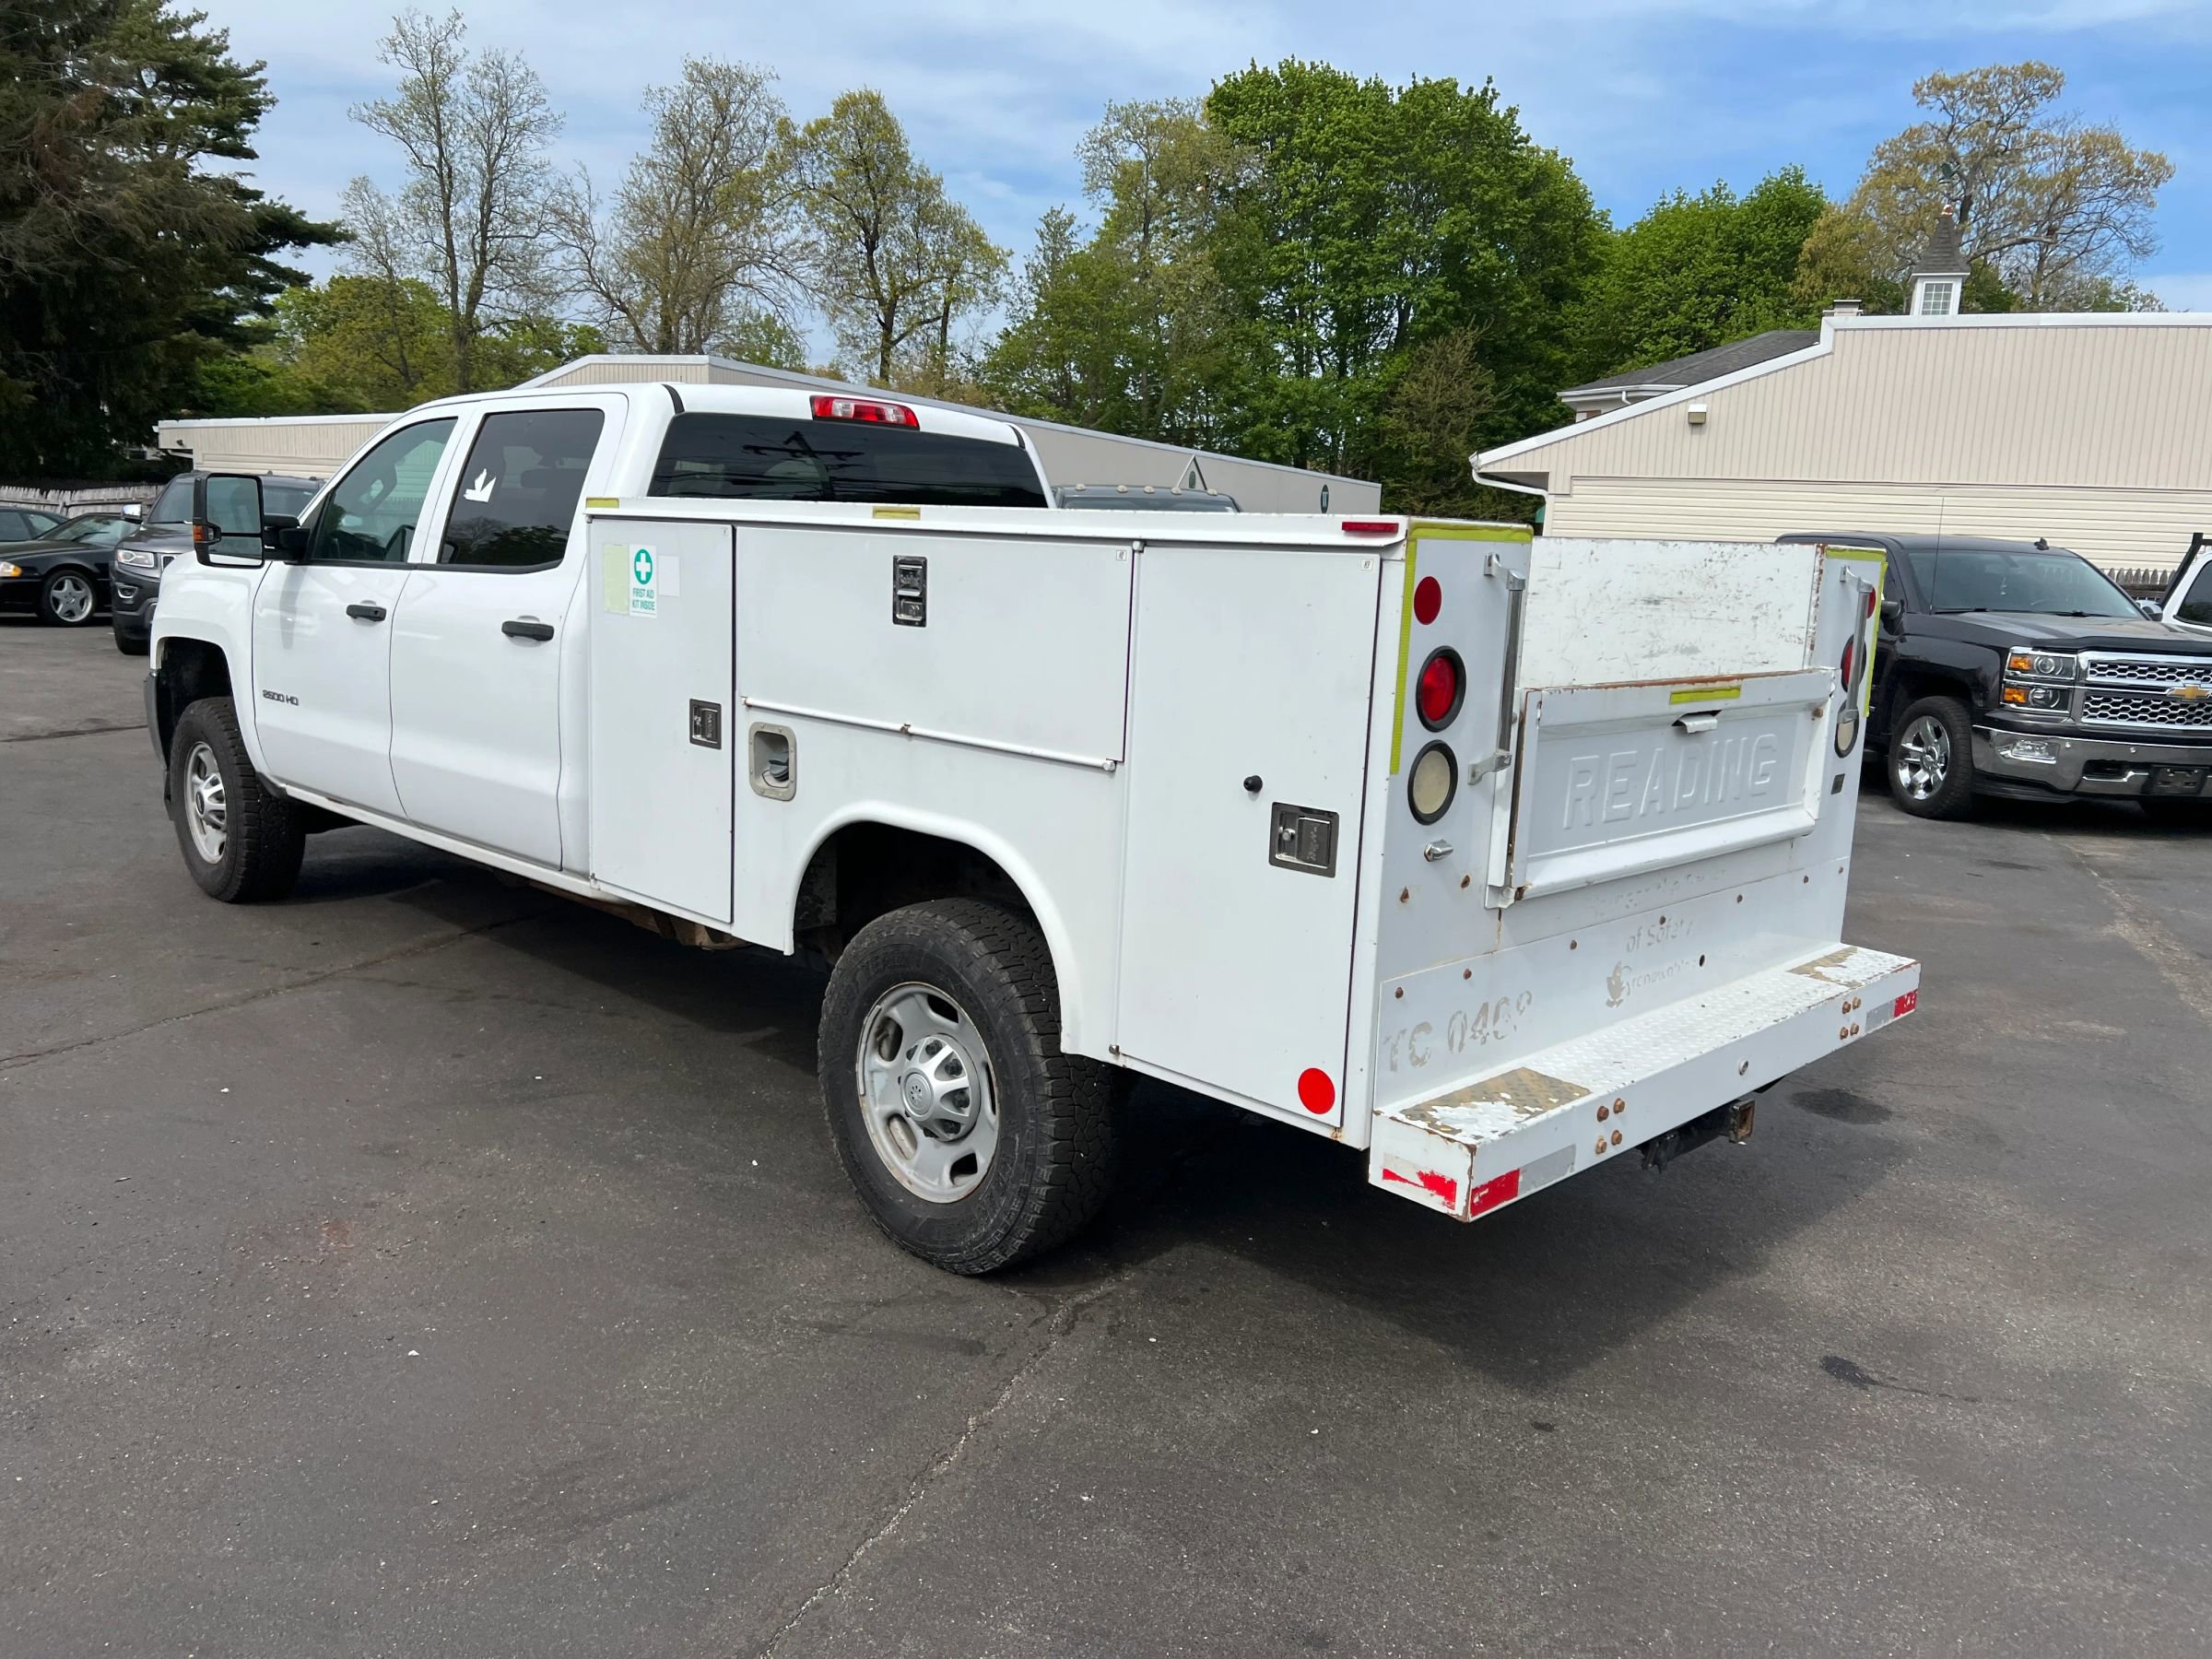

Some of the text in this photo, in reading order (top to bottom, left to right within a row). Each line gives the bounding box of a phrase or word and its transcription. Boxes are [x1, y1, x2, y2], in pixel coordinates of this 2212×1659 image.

[632, 587, 654, 599] FIRST AID
[640, 600, 655, 611] INSIDE
[263, 689, 300, 706] 2500 HD
[1563, 734, 1777, 830] READING
[1626, 926, 1642, 953] of
